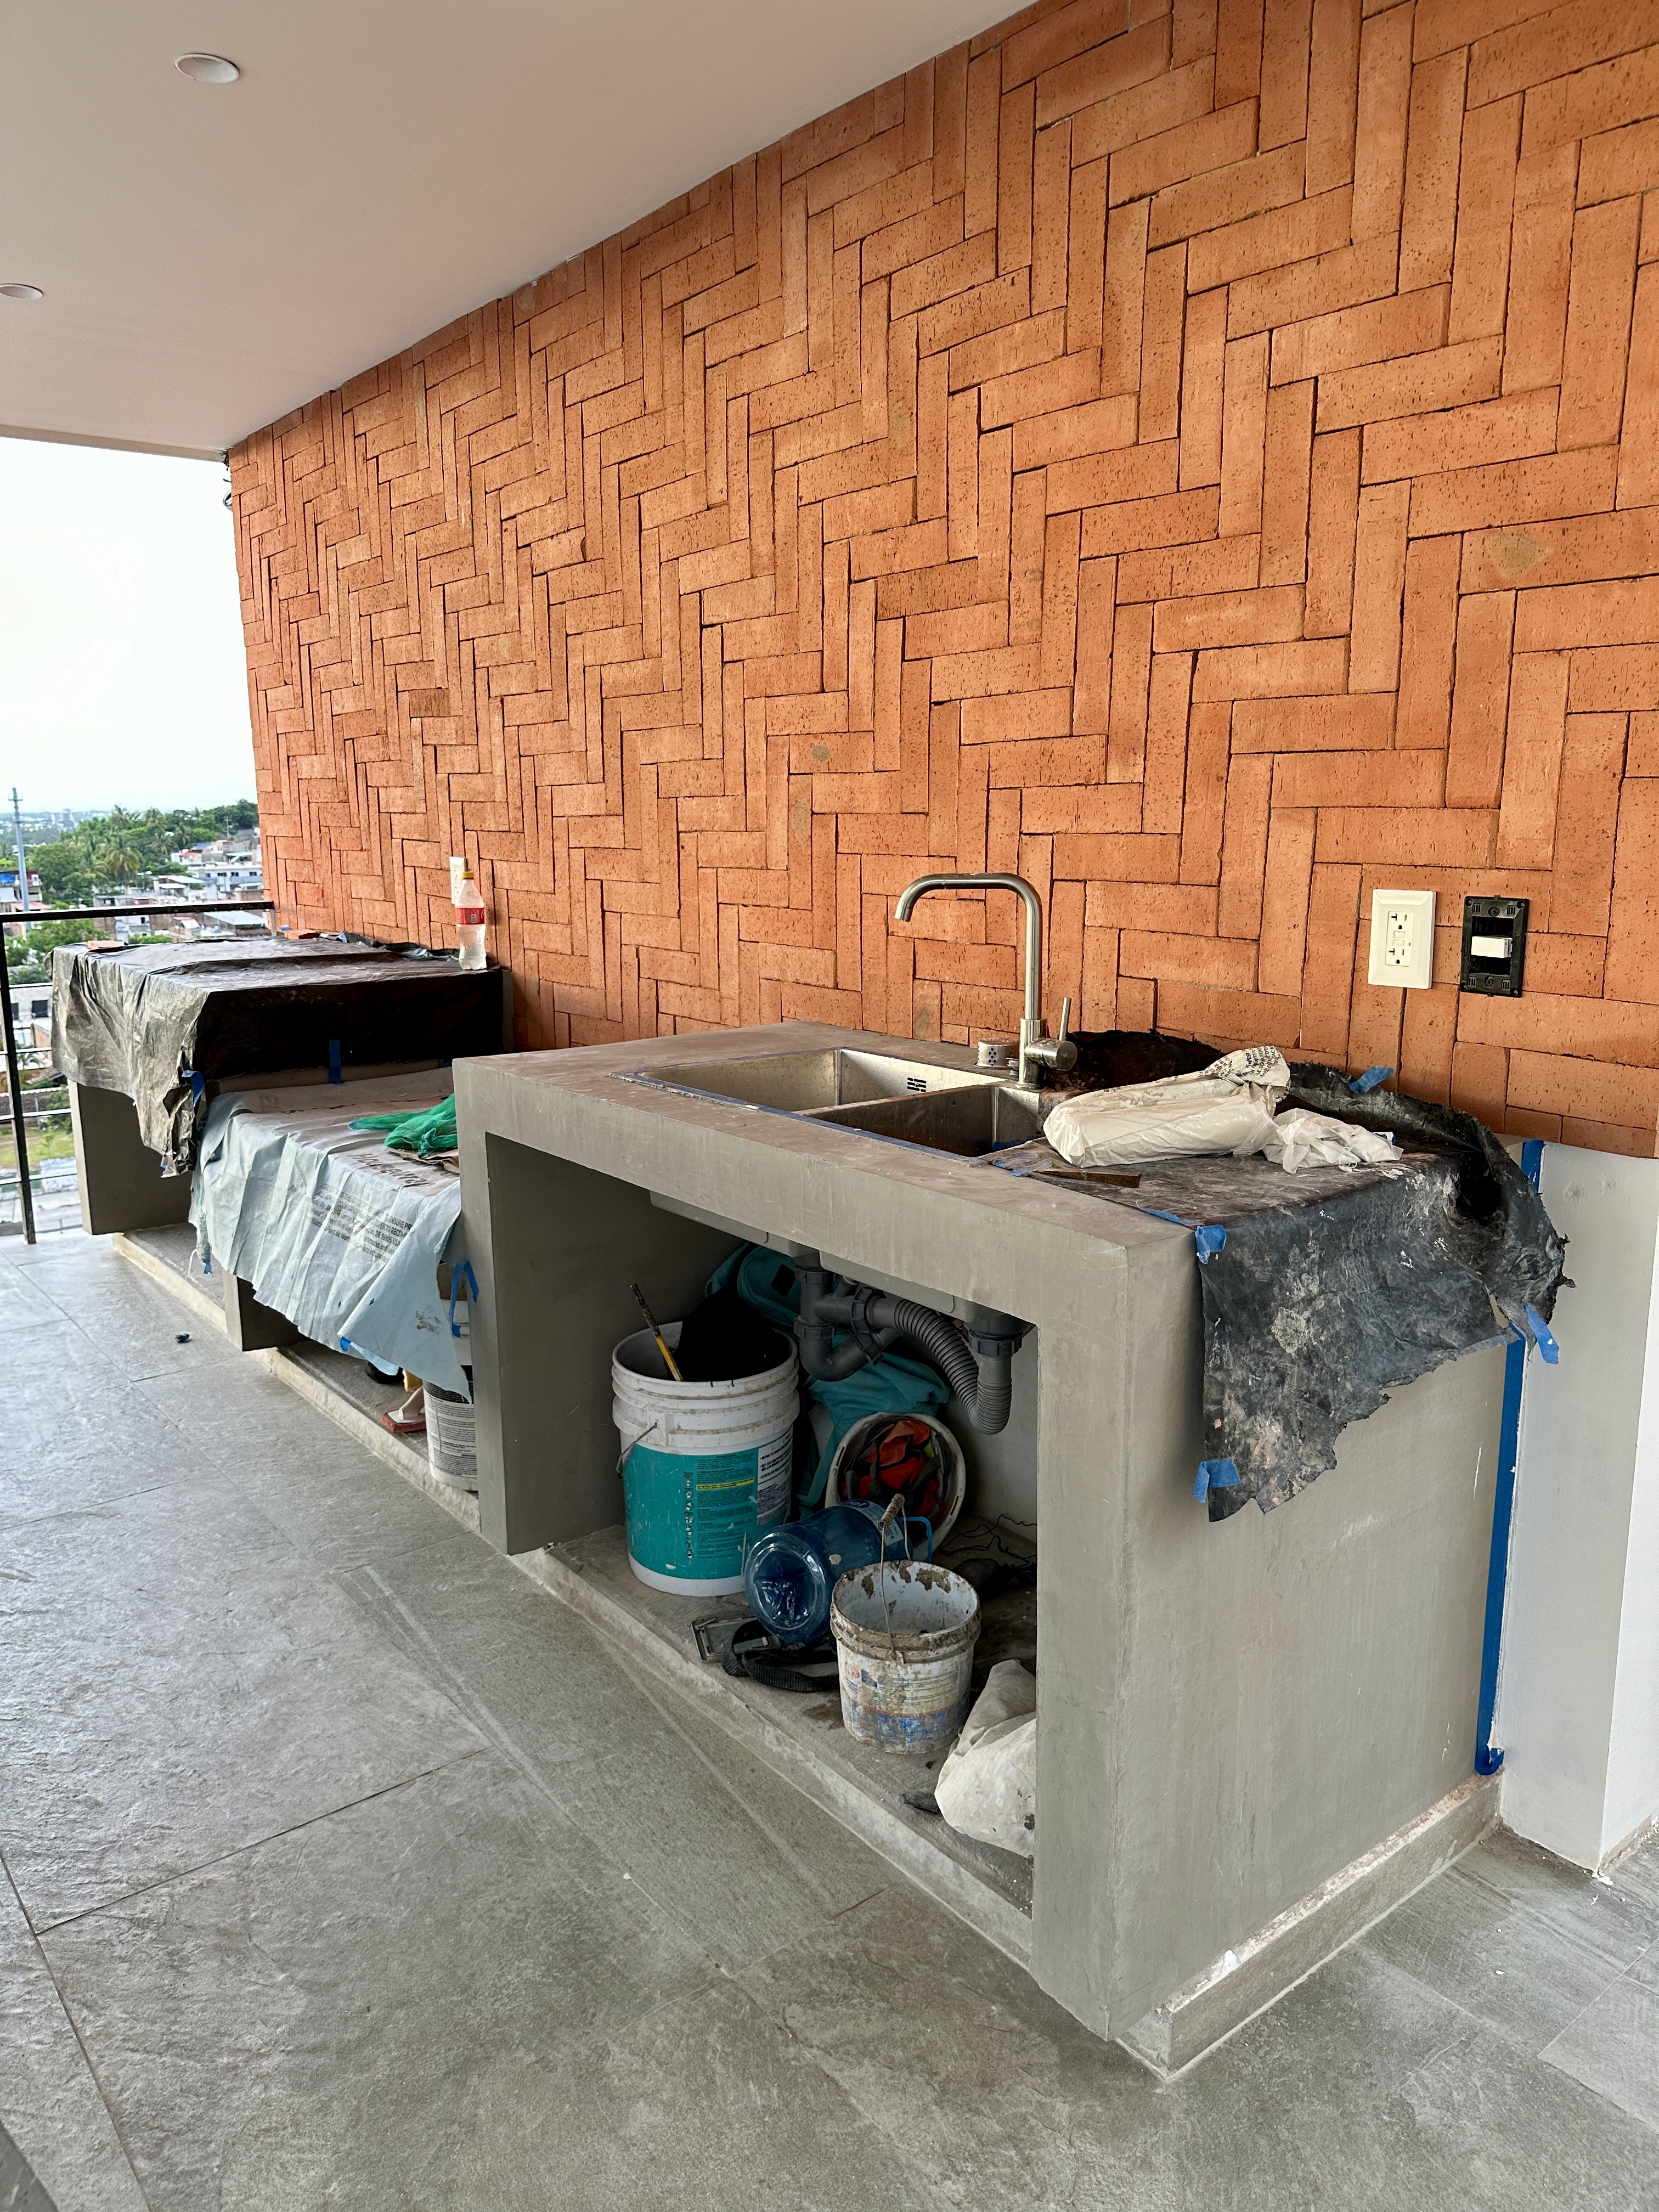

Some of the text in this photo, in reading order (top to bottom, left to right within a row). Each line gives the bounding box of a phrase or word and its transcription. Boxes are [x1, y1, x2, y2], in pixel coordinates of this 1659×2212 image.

[388, 1216, 405, 1228] ENSURE
[374, 1230, 382, 1238] DE
[392, 1238, 401, 1247] USA
